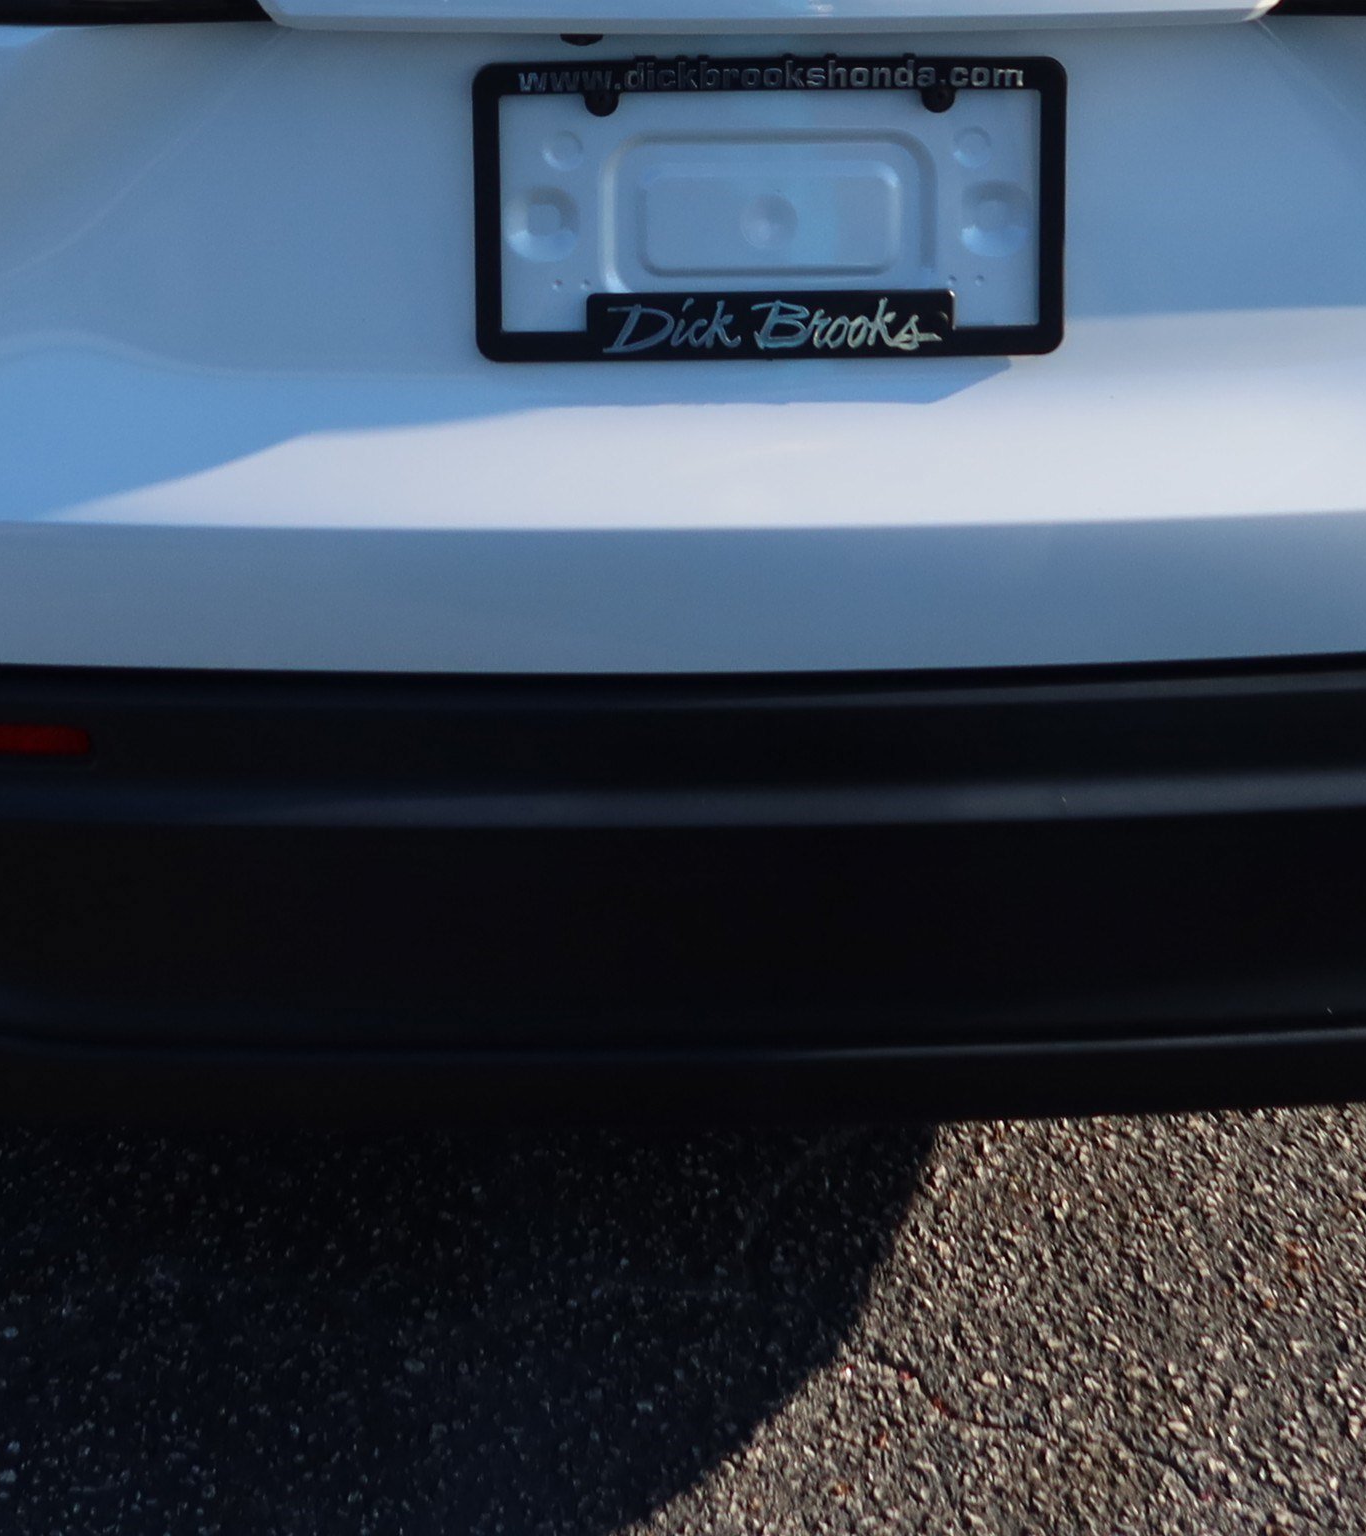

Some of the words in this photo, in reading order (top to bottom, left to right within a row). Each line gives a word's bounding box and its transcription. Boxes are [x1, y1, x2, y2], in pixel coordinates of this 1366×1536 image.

[518, 59, 1024, 91] www.dickbrookshonda.com
[602, 298, 741, 354] Dick
[751, 298, 943, 352] Brooks
